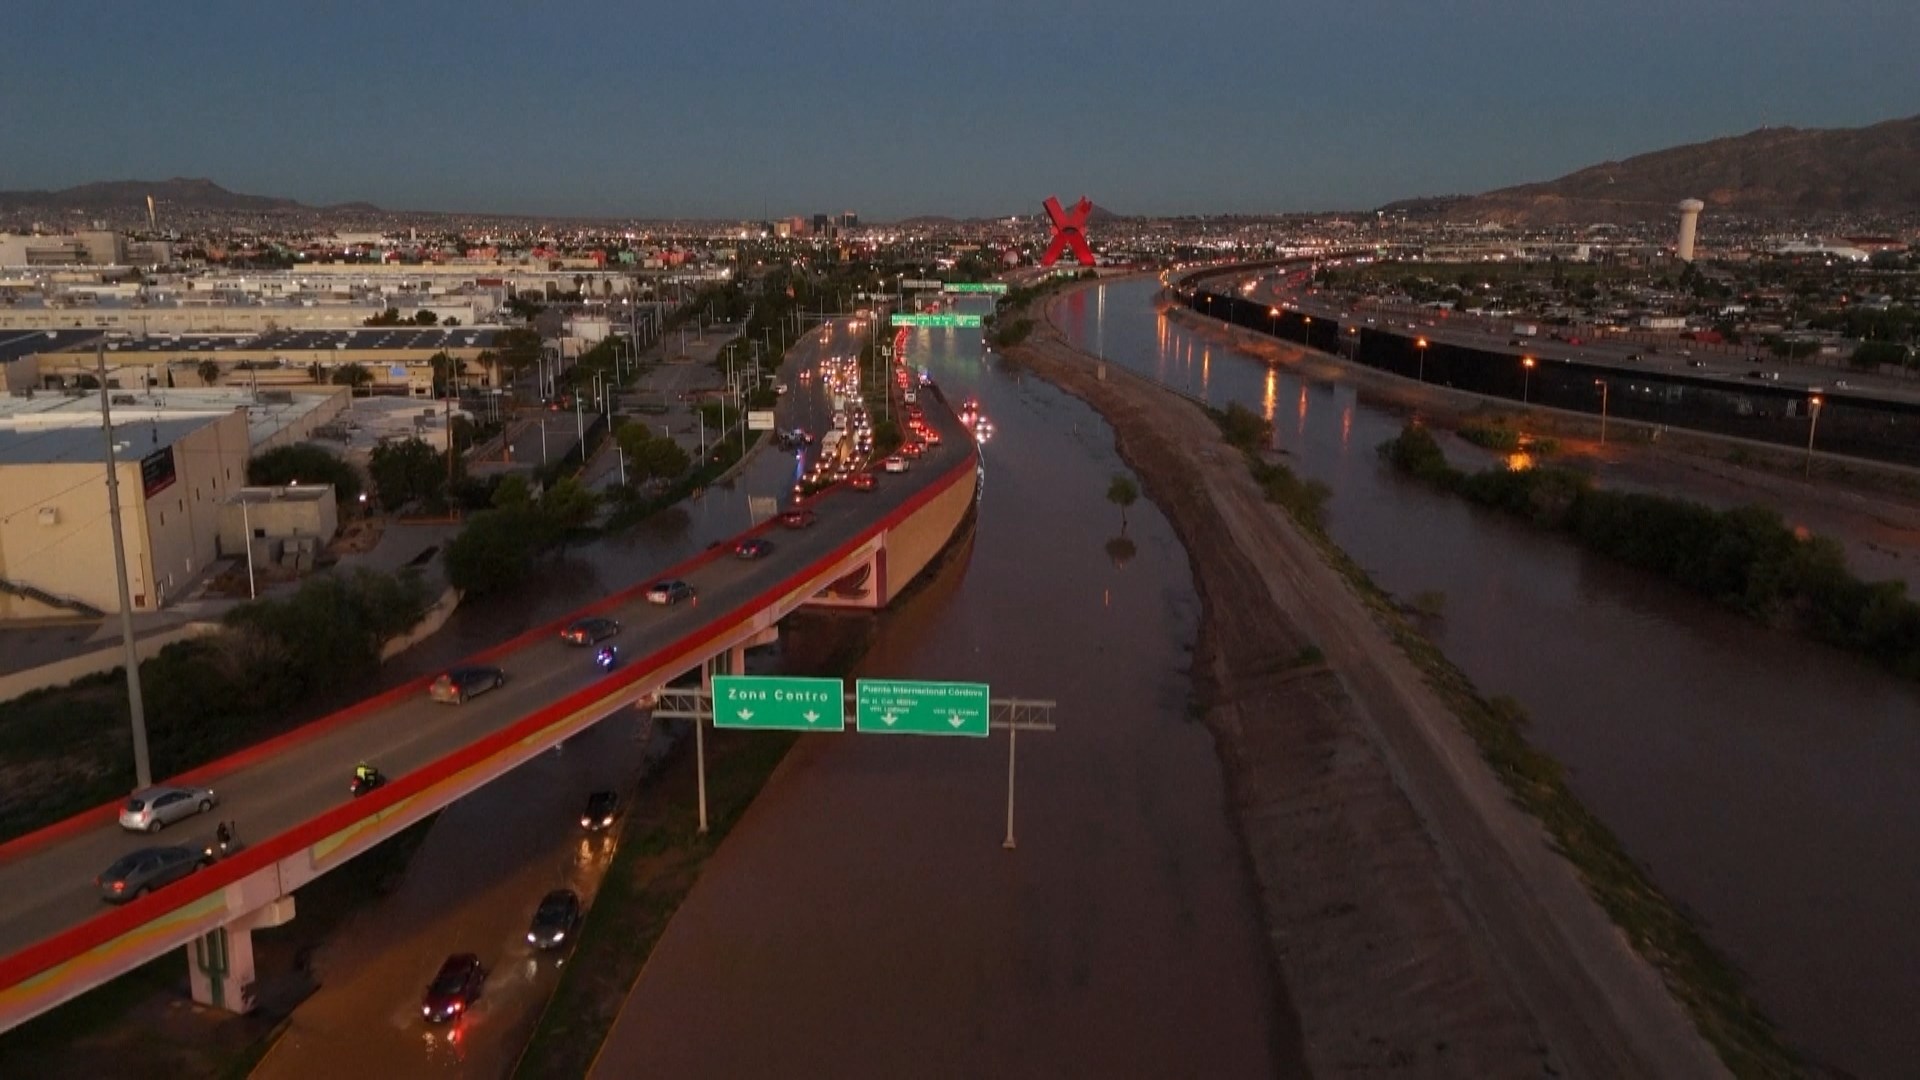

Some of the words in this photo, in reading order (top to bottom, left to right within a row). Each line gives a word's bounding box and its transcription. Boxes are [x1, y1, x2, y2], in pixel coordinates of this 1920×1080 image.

[728, 688, 766, 700] Zona
[774, 689, 828, 702] Centro
[863, 685, 891, 694] Puente
[893, 686, 946, 696] Internacional
